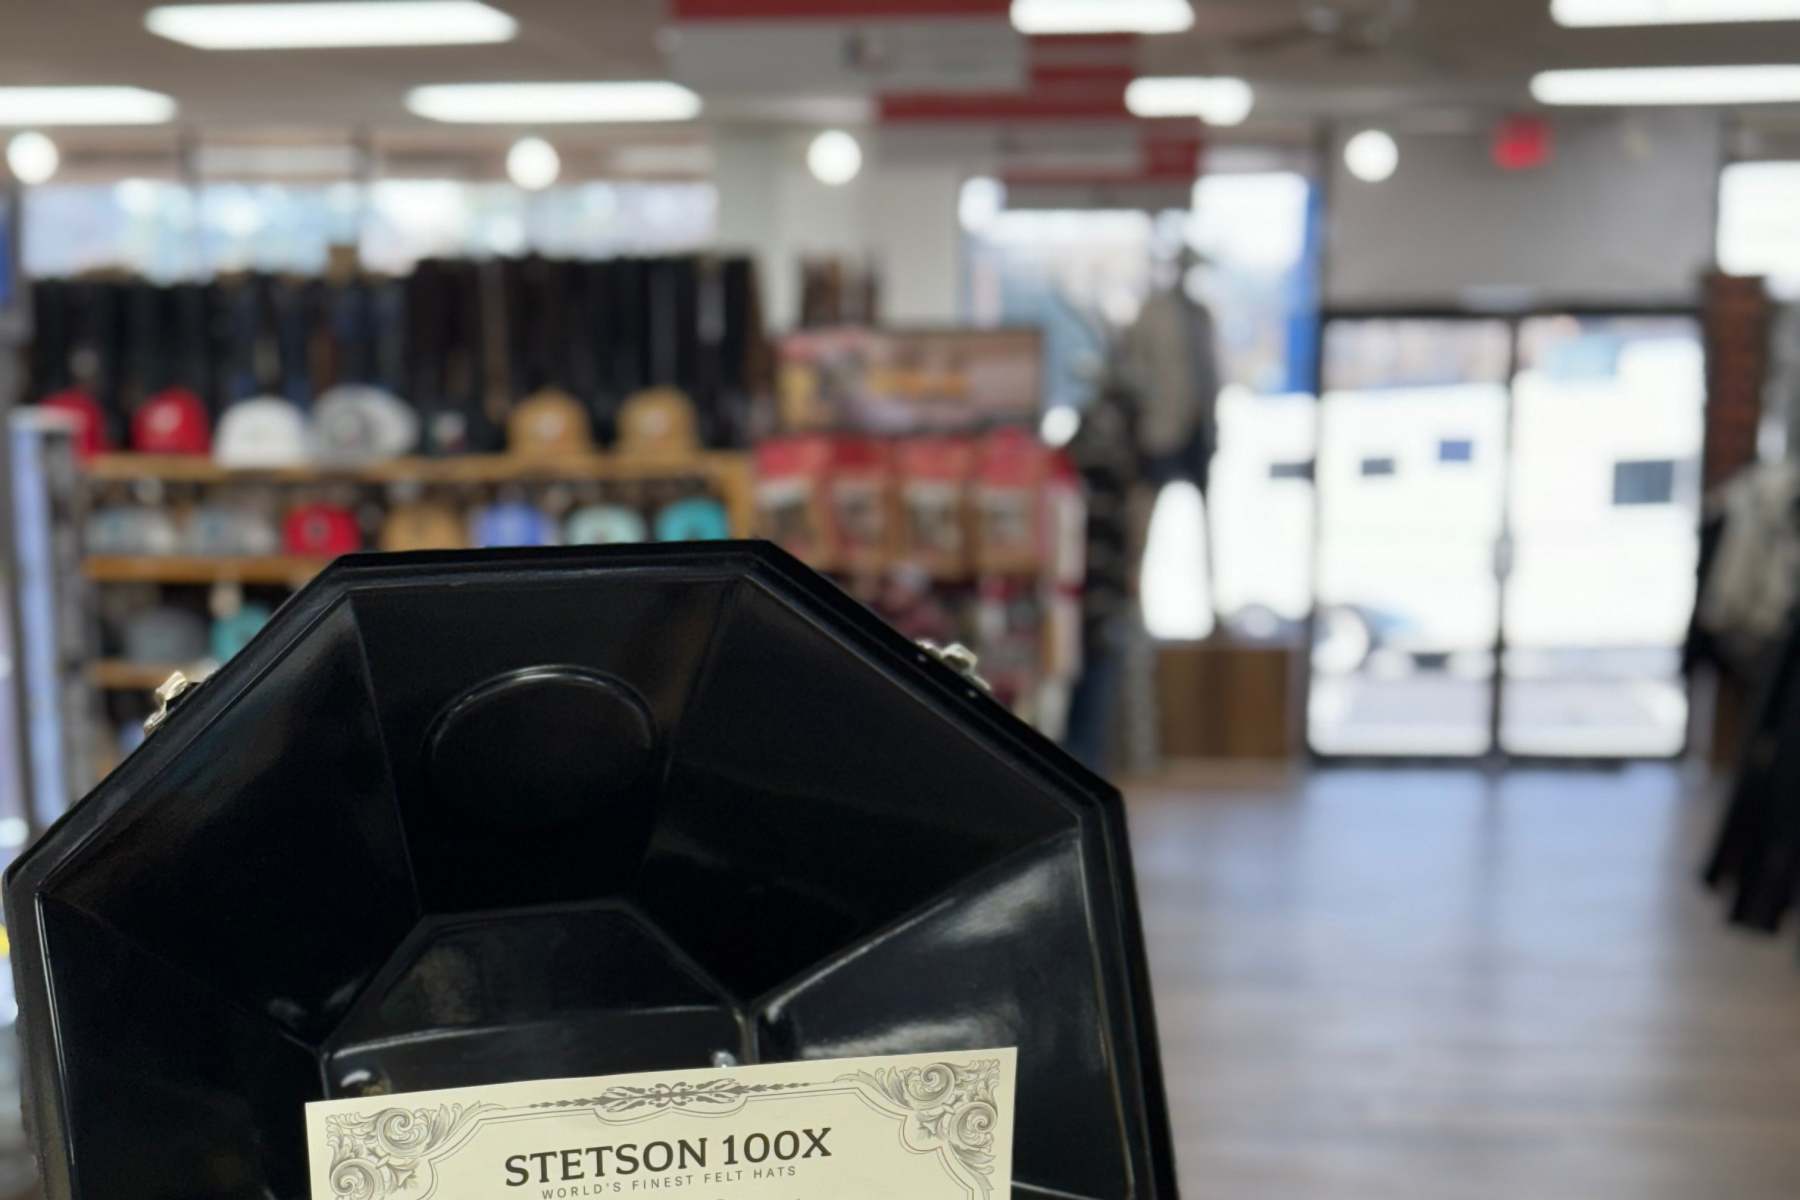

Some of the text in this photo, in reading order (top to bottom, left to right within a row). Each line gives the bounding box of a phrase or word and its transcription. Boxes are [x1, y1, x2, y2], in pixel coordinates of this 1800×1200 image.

[505, 1127, 832, 1187] STETSON 100X
[542, 1166, 797, 1200] WORLD'S FINEST FELT HATS
